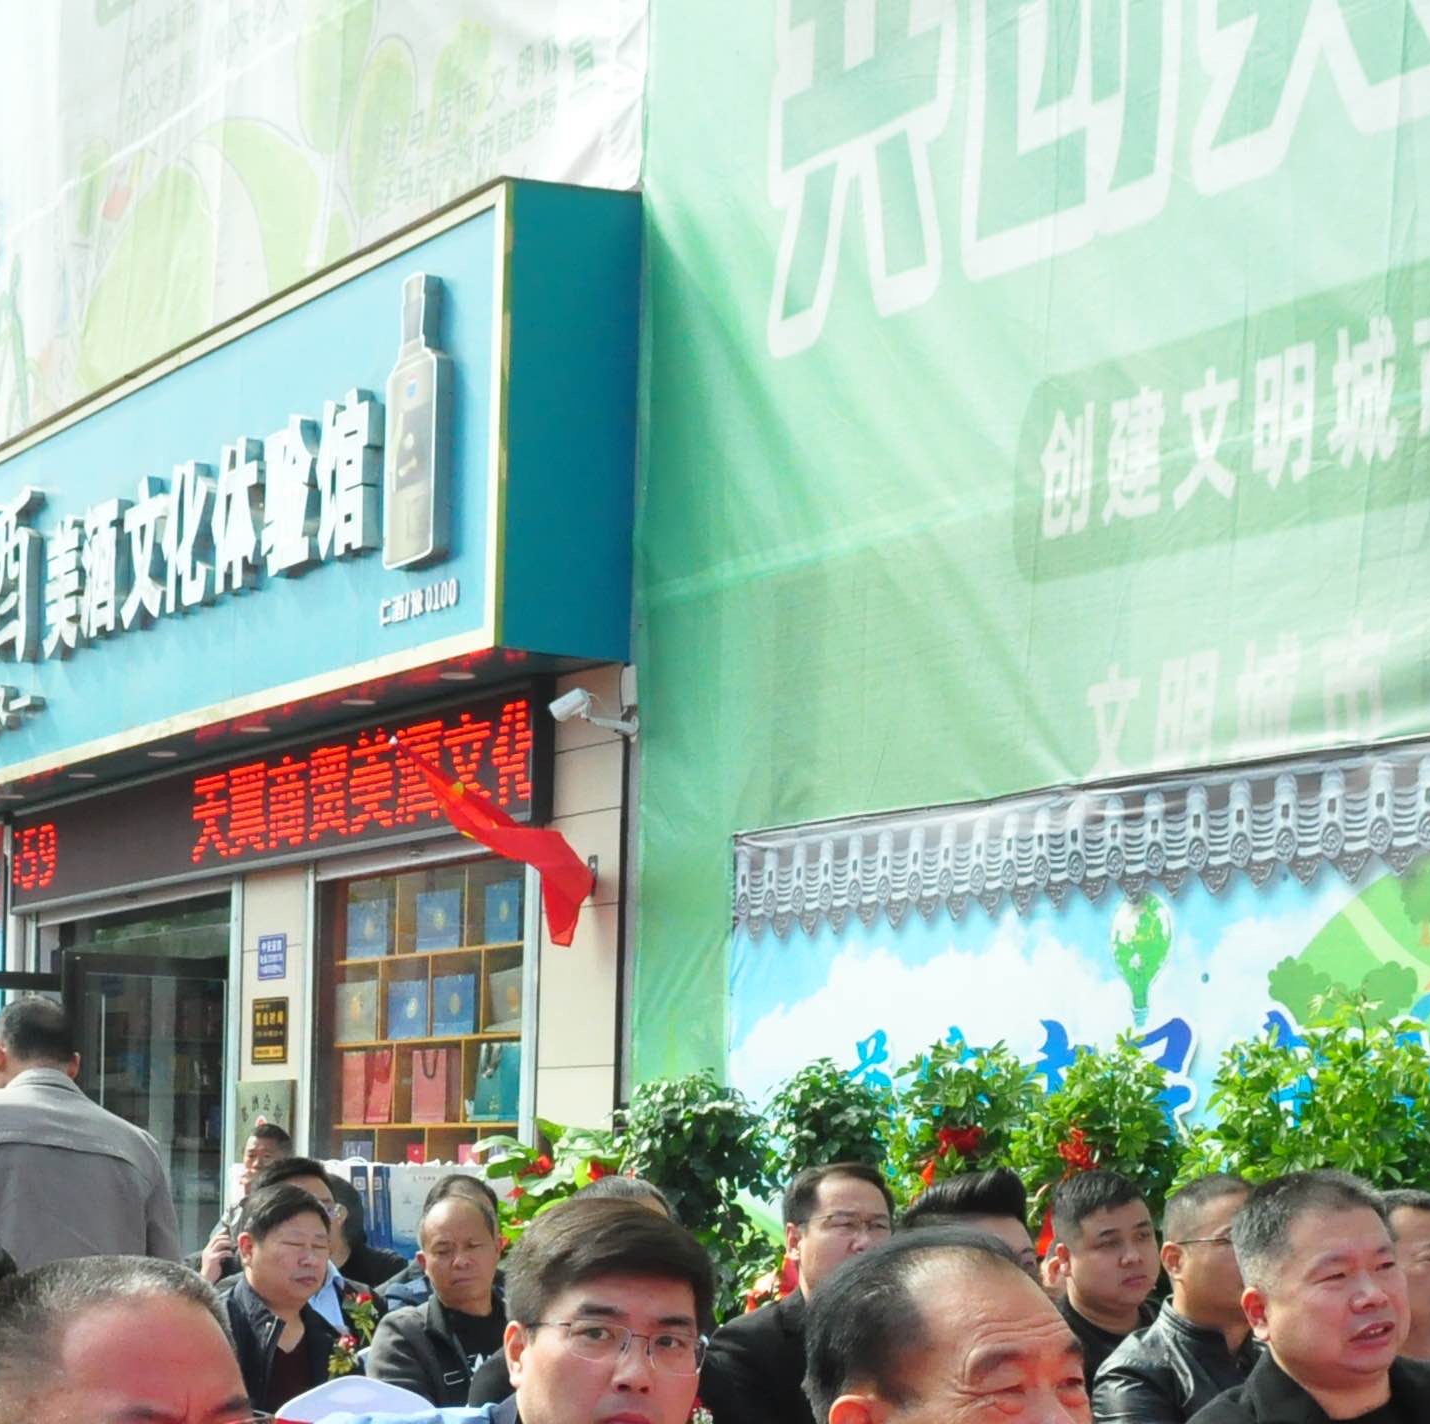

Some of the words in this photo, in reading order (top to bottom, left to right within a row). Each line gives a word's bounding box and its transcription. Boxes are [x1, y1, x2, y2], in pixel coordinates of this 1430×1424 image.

[44, 389, 381, 658] 美酒文化体验馆
